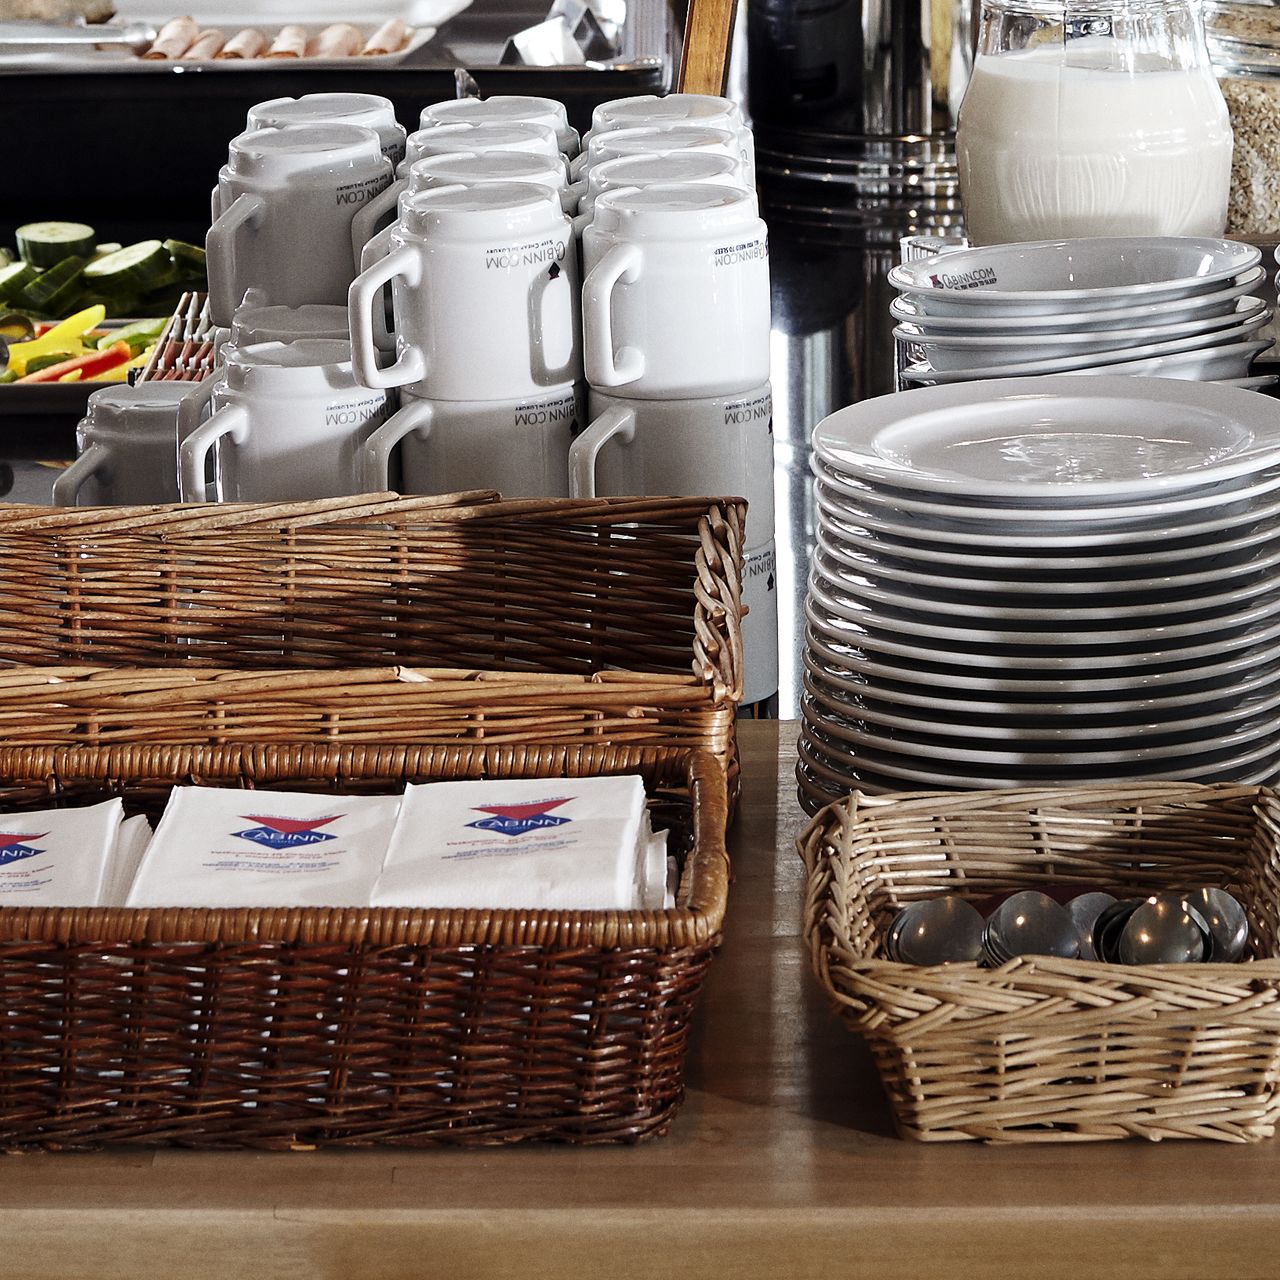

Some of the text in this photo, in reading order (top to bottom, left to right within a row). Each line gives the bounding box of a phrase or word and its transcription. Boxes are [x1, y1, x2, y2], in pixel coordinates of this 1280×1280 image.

[714, 242, 765, 268] CABINN.COM
[942, 267, 996, 289] CABINN.COM
[474, 818, 560, 829] CABINN
[240, 829, 326, 841] CABINN
